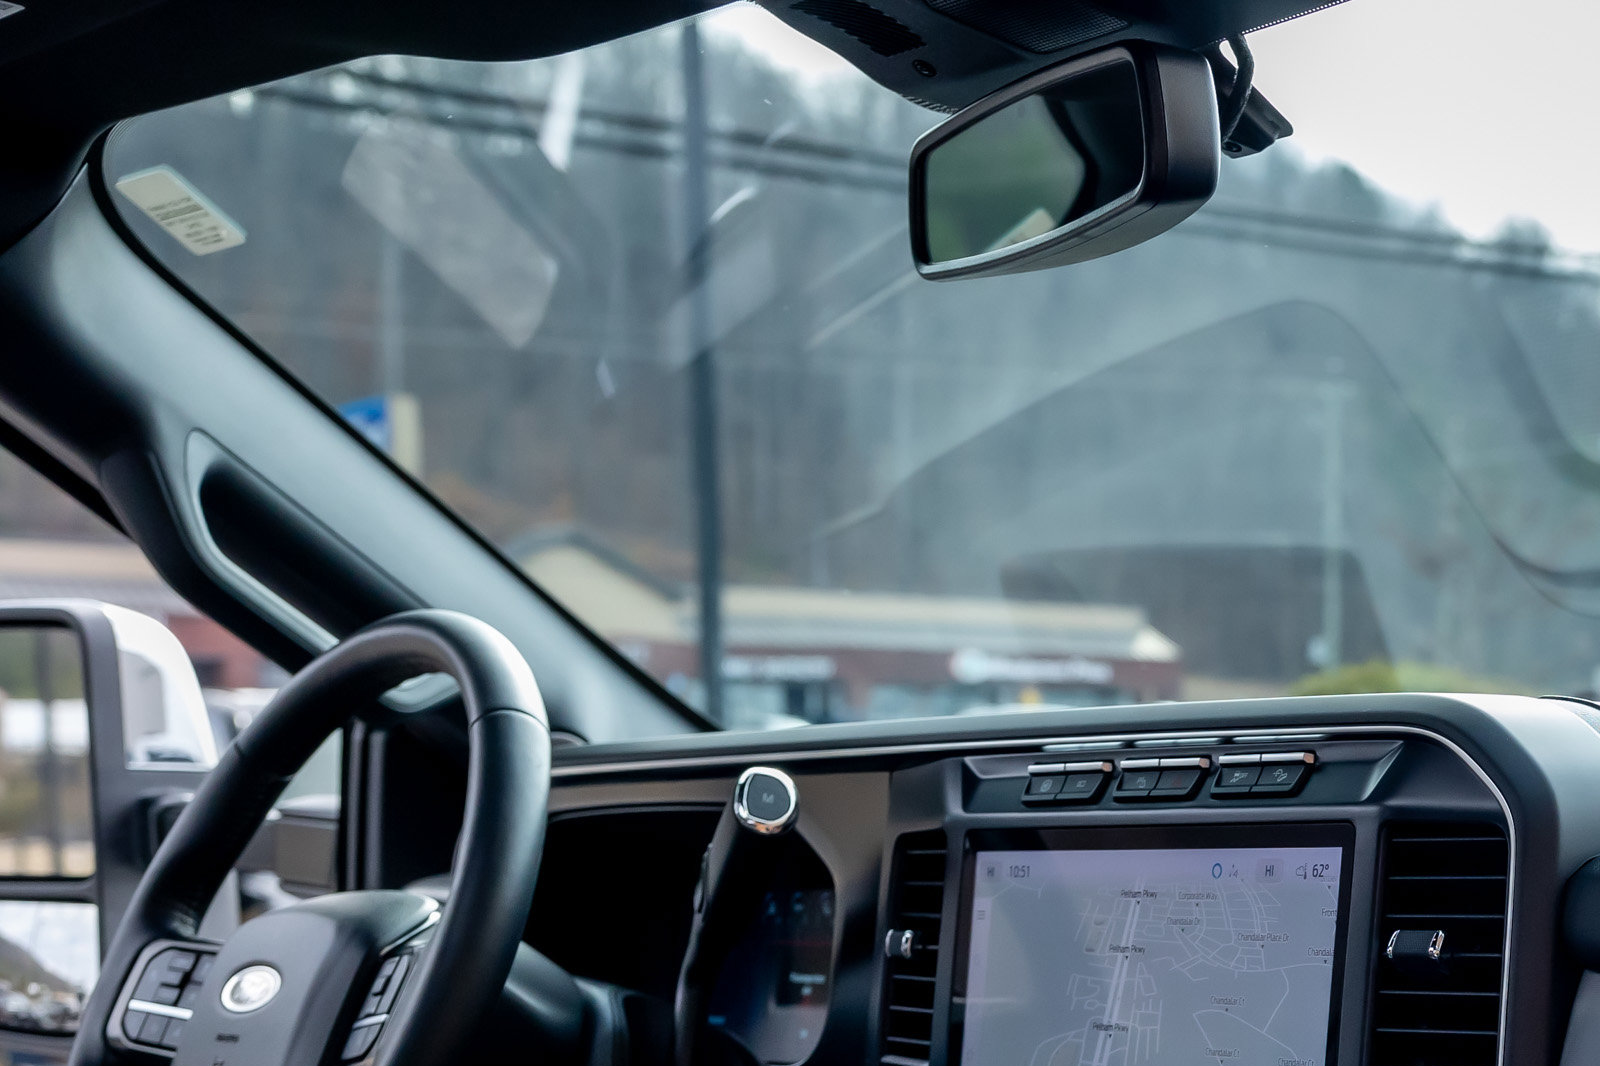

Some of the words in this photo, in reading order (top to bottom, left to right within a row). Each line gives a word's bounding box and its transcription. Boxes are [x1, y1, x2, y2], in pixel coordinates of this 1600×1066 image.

[1009, 865, 1031, 878] 10:51
[1265, 865, 1275, 877] HI
[1312, 863, 1330, 878] 62°
[1120, 889, 1142, 899] Pelham
[1108, 944, 1130, 953] Pelham
[1092, 1022, 1113, 1031] Pelham
